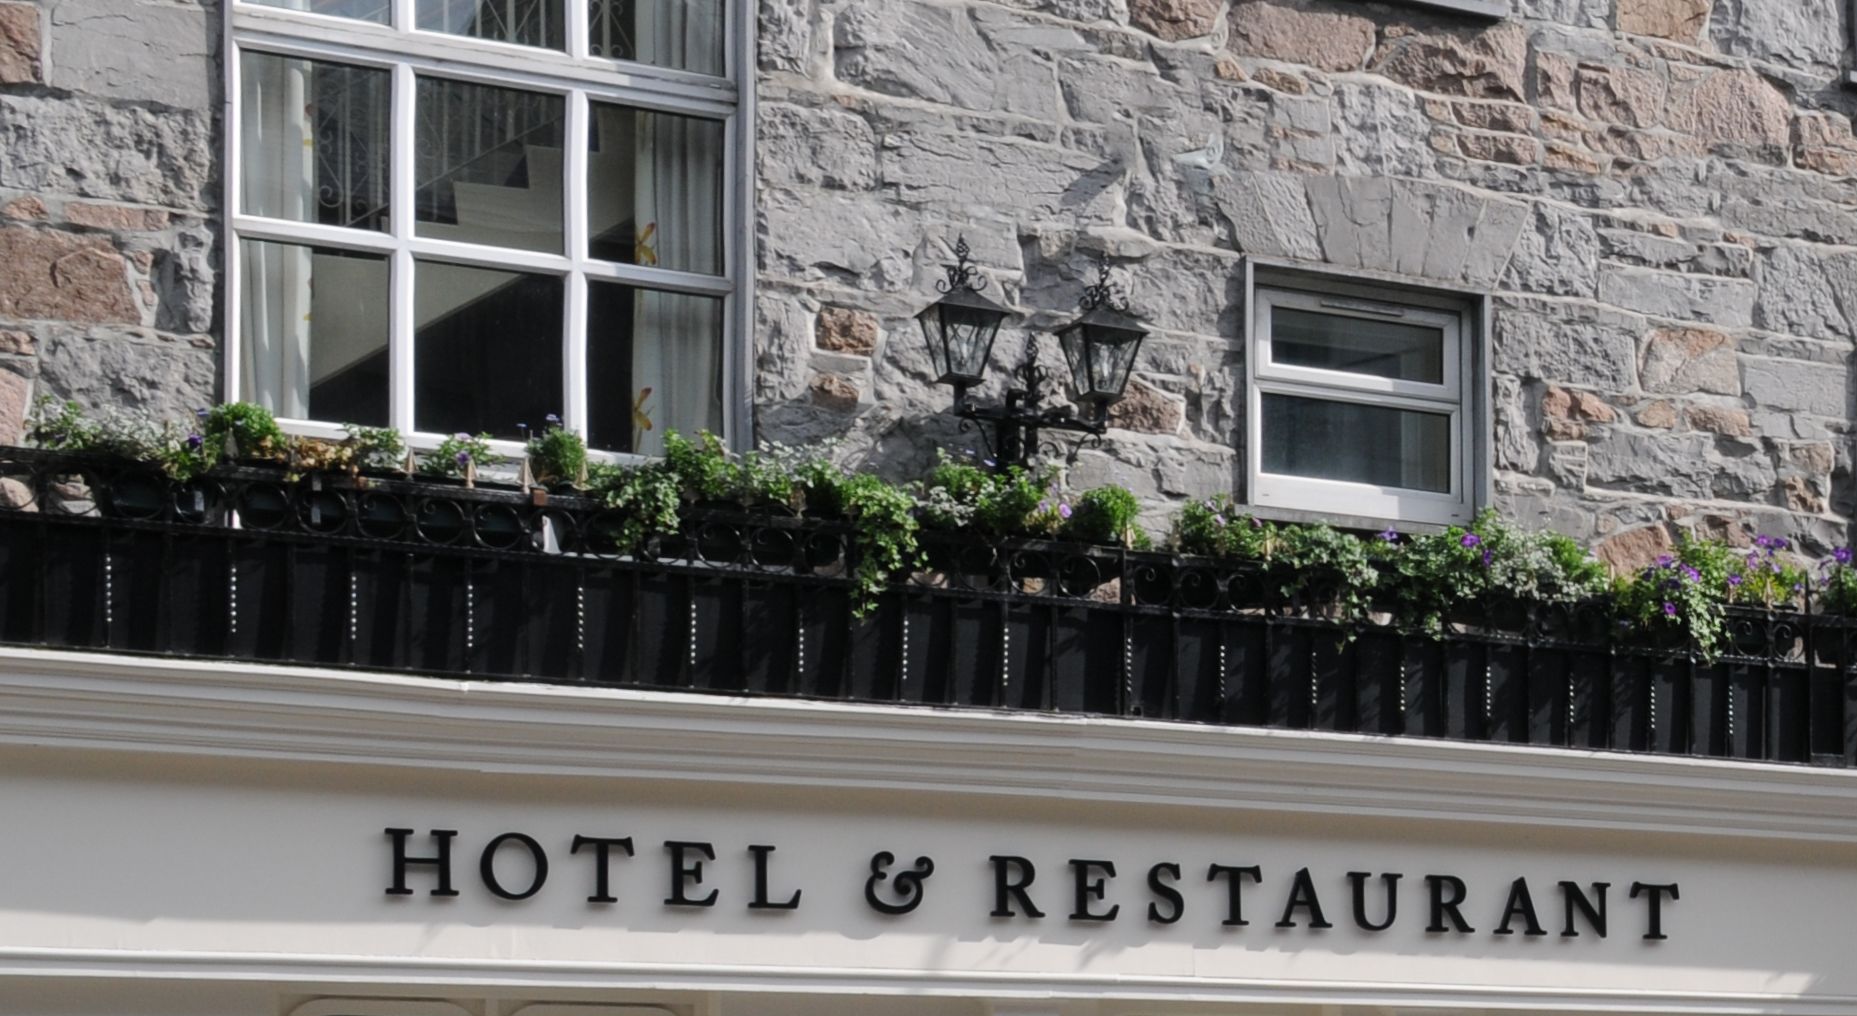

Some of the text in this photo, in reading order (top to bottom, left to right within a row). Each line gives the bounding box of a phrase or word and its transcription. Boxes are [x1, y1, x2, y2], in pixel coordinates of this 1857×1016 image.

[384, 827, 1681, 940] HOTEL & RESTAURANT
